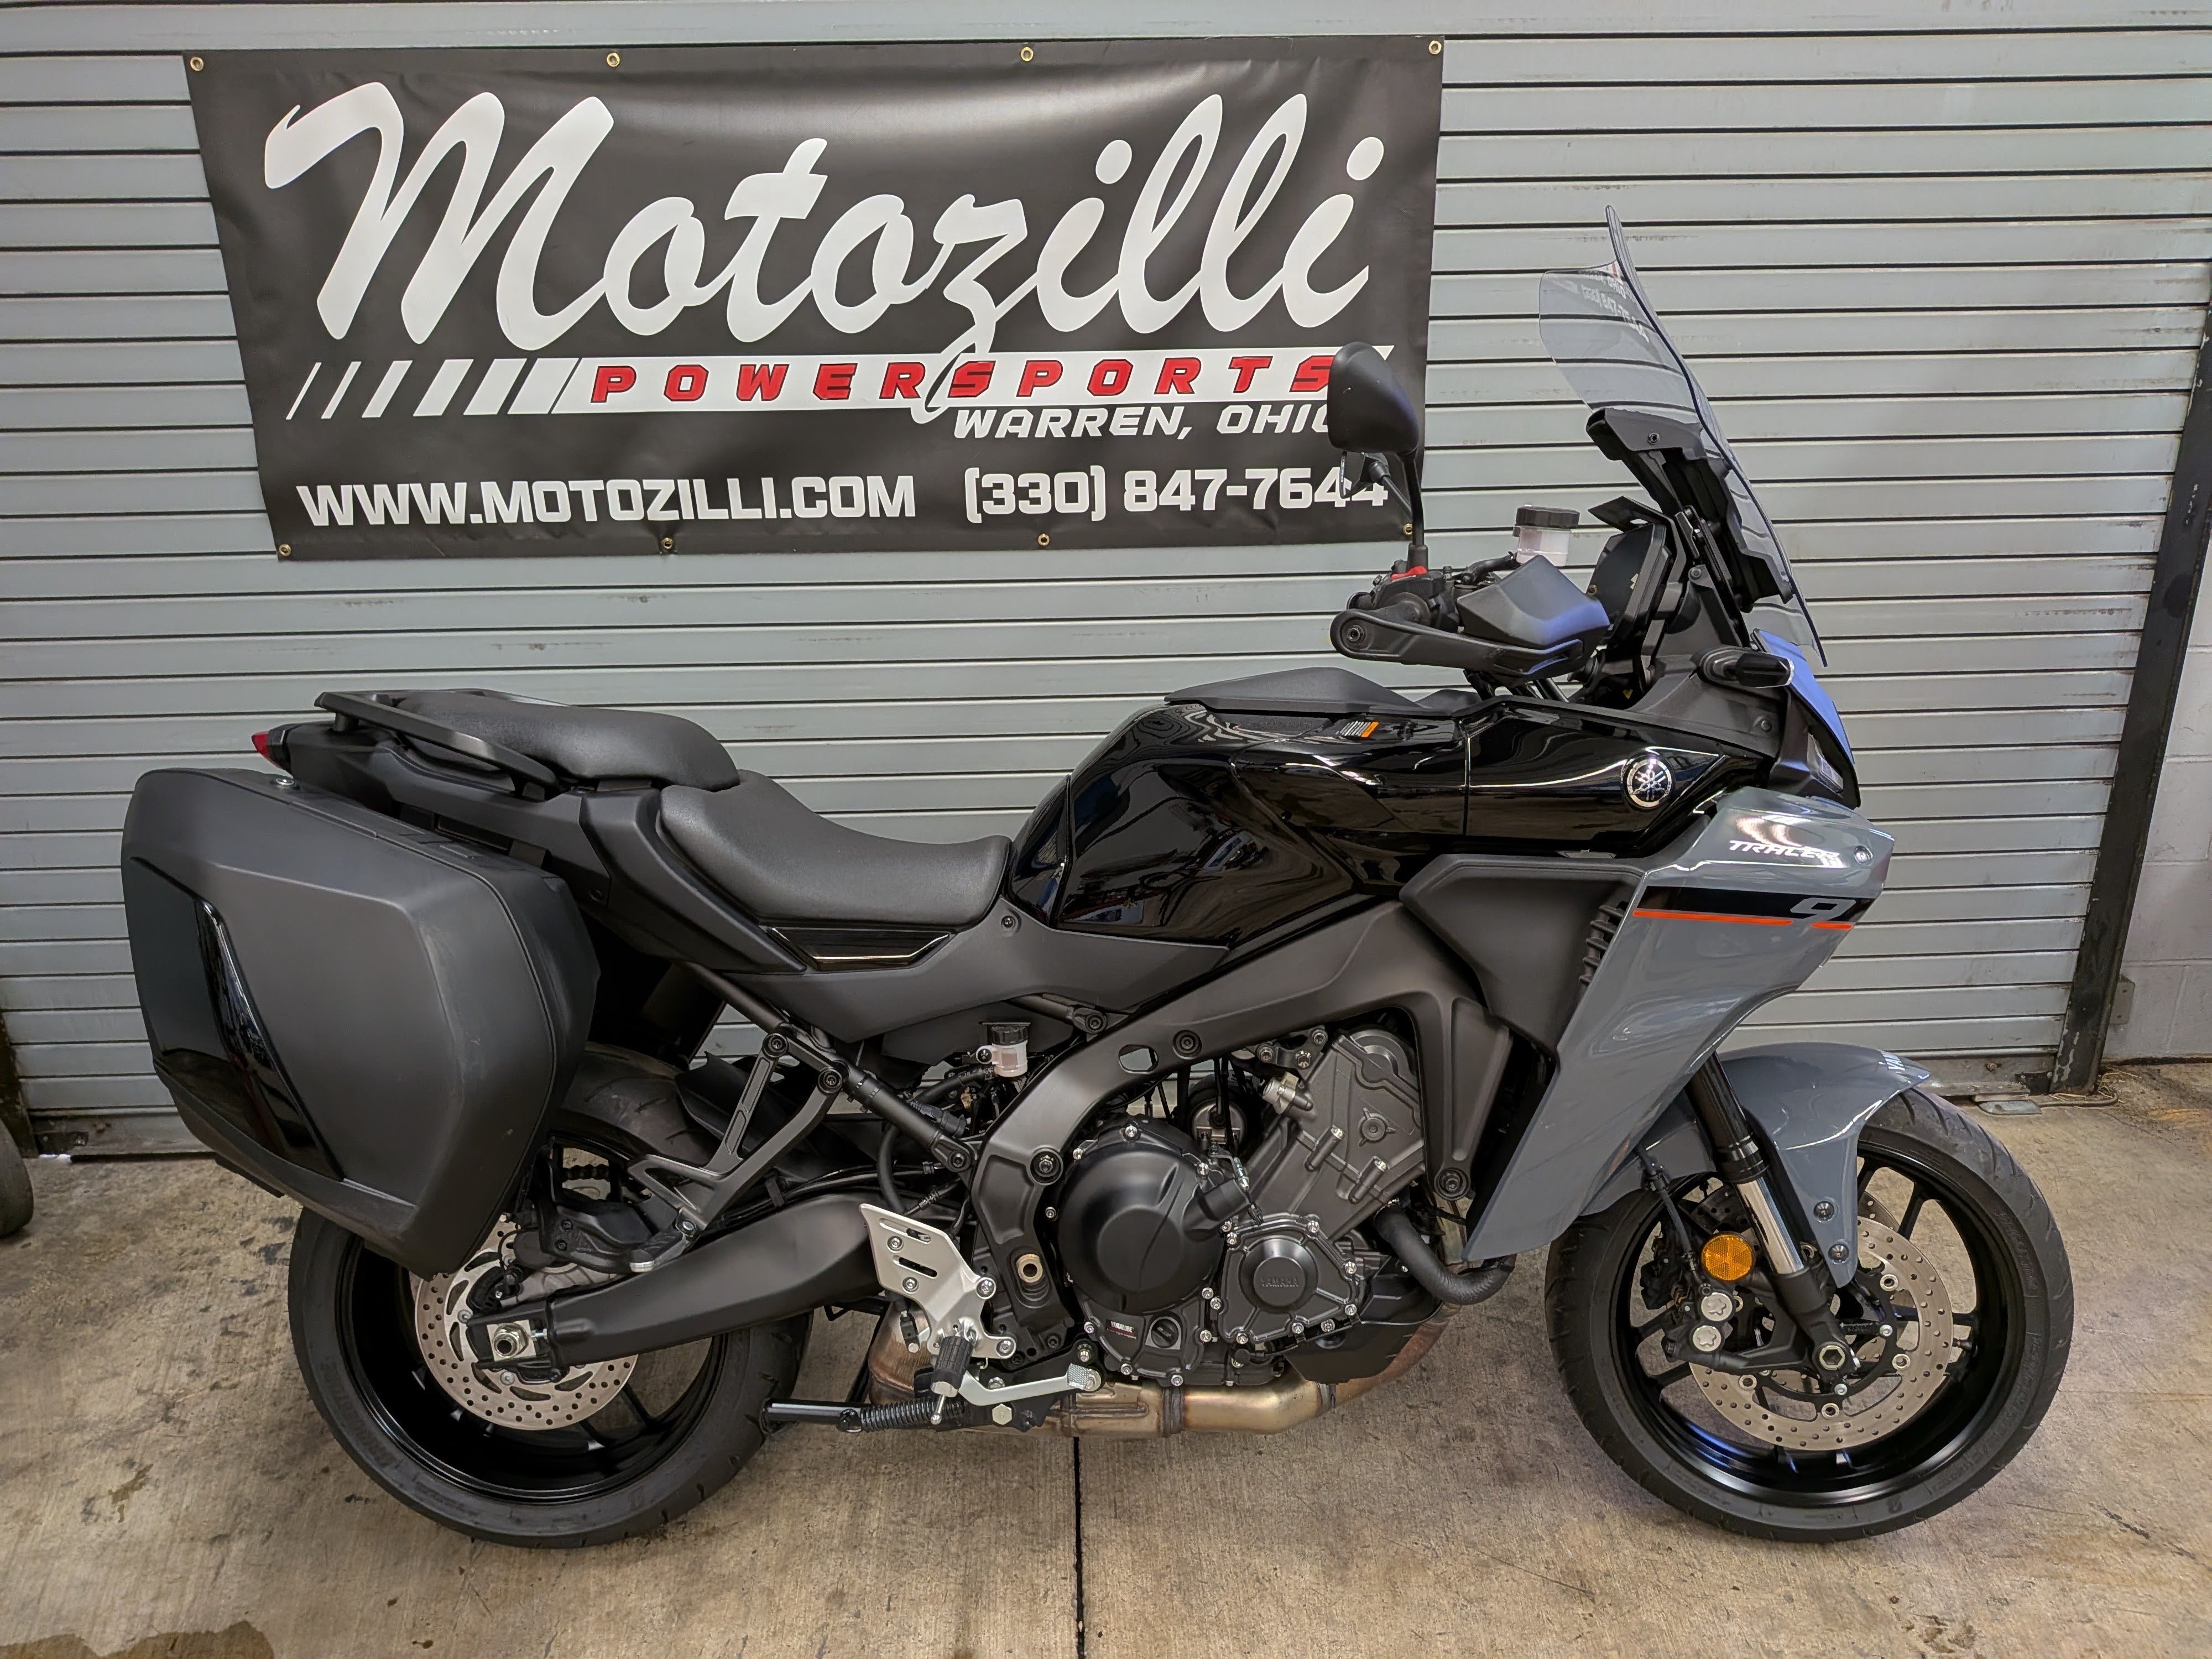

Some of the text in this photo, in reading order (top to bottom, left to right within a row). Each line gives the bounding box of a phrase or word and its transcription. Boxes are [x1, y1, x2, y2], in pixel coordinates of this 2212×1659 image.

[265, 82, 1384, 424] Motozilli
[591, 356, 1333, 402] POWERSPORTS
[954, 405, 1192, 440] WARREN,
[296, 476, 916, 526] WWW.MOTOZILLI.COM
[1124, 467, 1389, 512] 847-7644
[1729, 840, 1840, 862] TRACER
